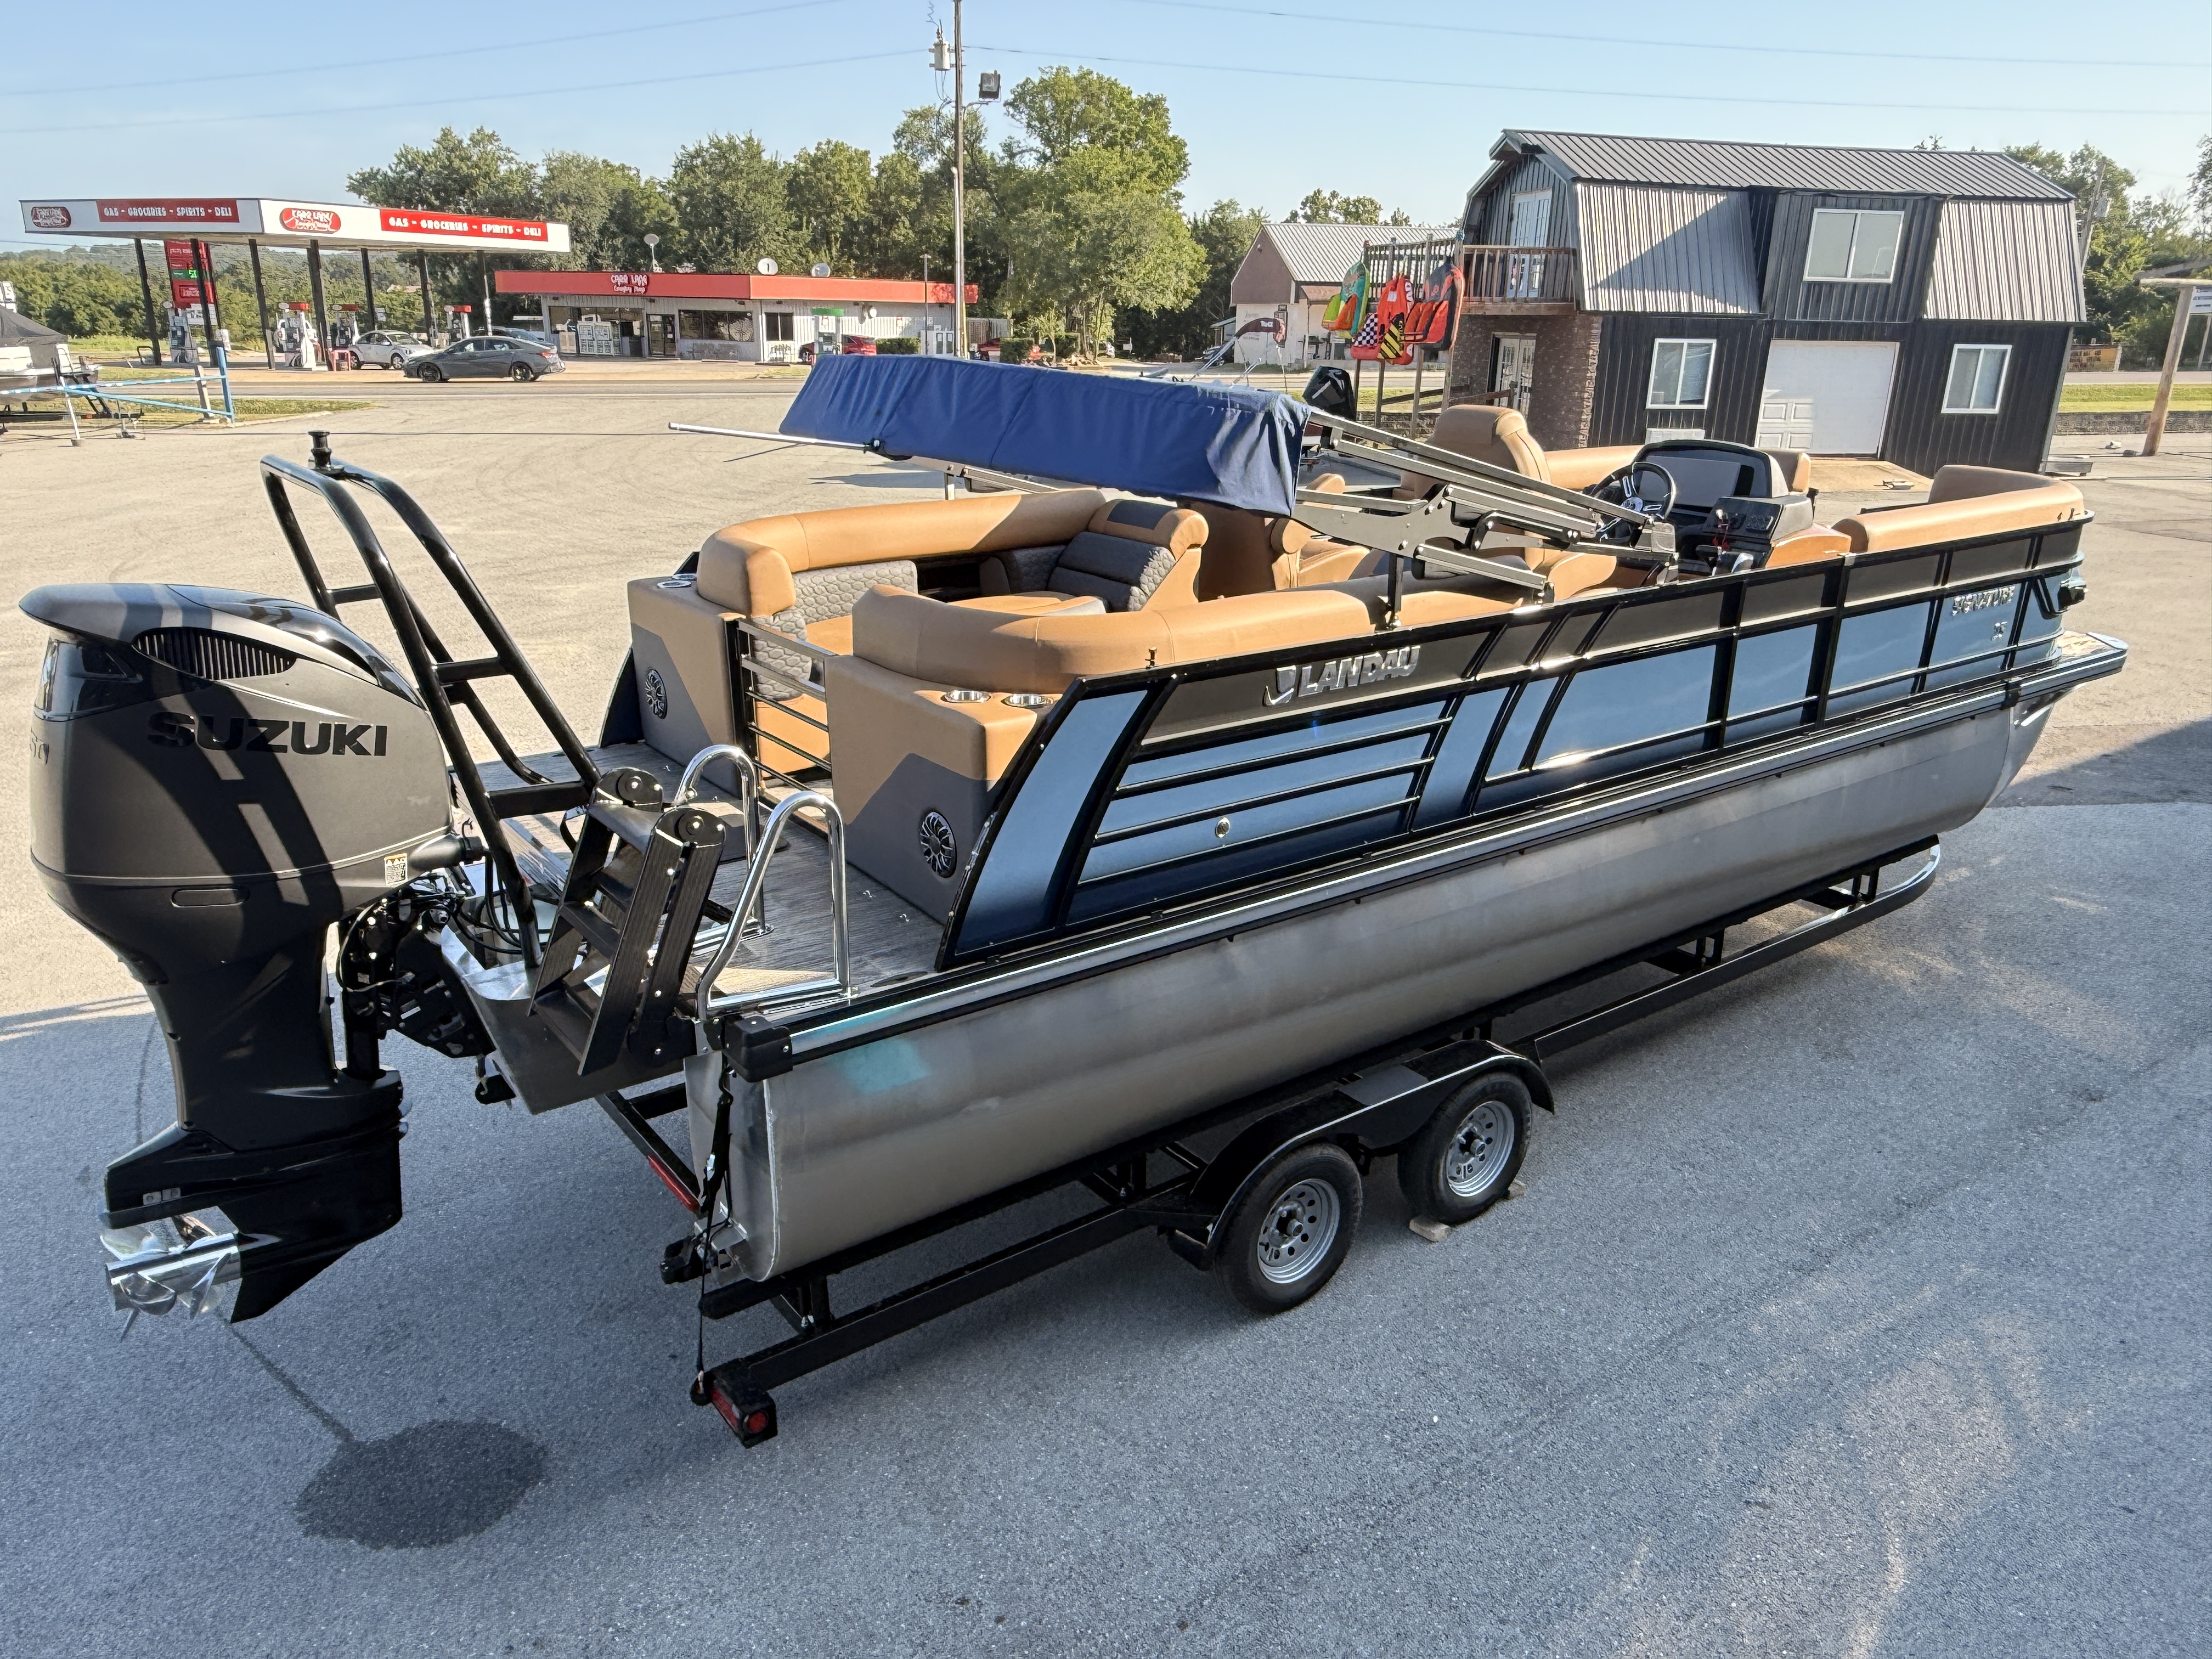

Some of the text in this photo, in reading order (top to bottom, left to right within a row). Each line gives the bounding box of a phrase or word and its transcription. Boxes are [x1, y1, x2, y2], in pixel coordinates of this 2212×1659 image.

[388, 217, 409, 228] GAS
[482, 224, 514, 234] SPIRITS
[523, 227, 541, 236] DELI
[1297, 645, 1421, 697] LANDAU
[146, 712, 387, 756] SUZUKI
